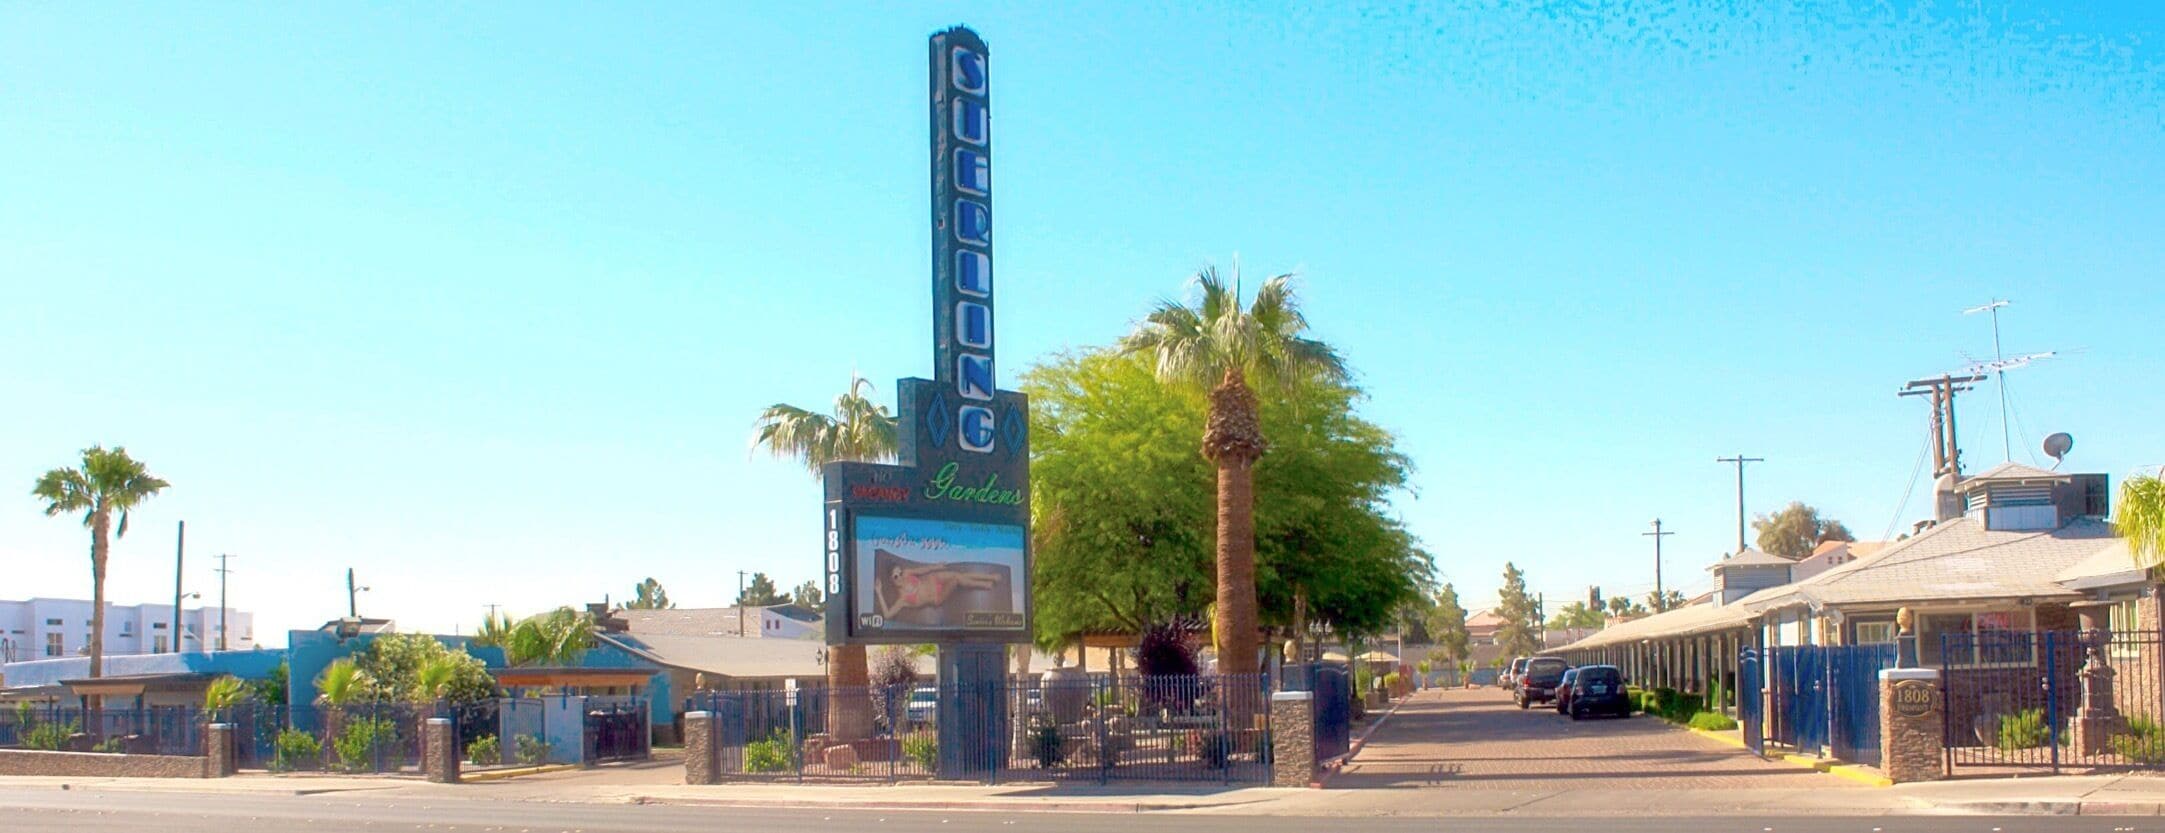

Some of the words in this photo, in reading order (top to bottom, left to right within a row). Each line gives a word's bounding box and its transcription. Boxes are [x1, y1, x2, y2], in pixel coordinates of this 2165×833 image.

[953, 47, 994, 451] STERLING
[924, 462, 1024, 505] Gardens
[828, 509, 840, 594] 1808
[1896, 689, 1930, 703] 1808
